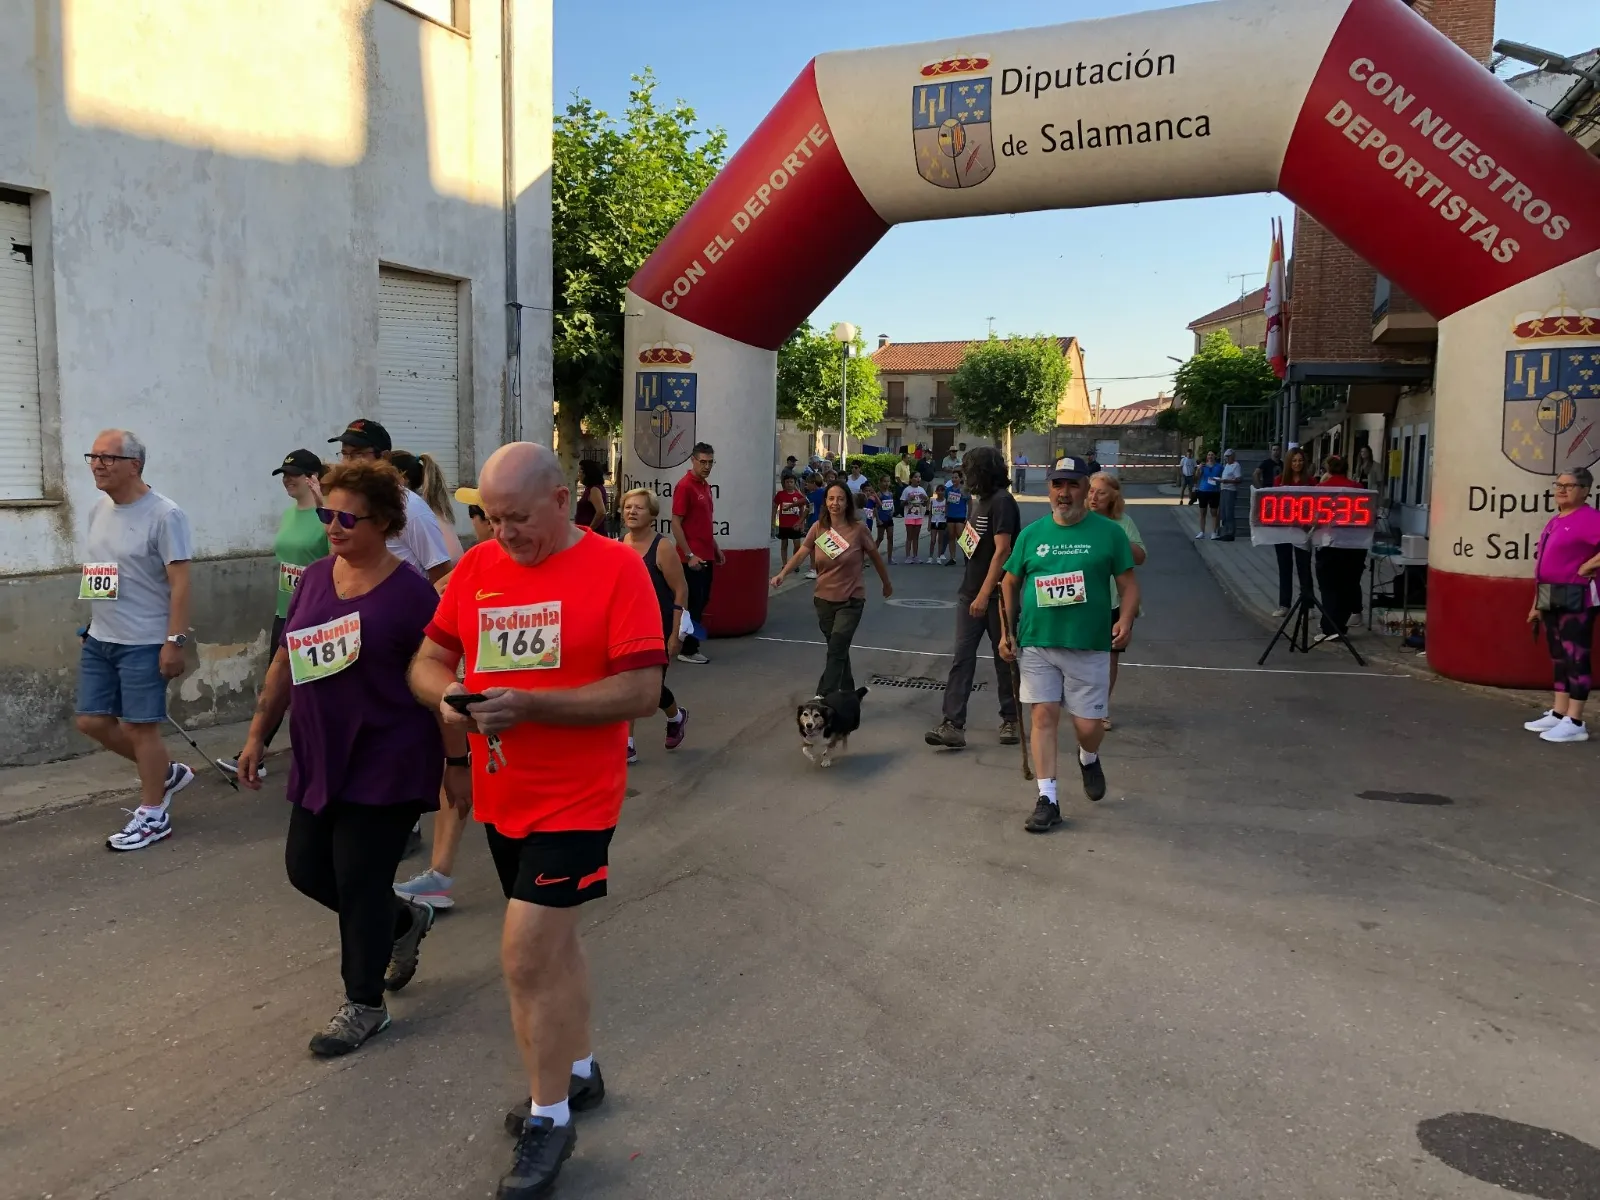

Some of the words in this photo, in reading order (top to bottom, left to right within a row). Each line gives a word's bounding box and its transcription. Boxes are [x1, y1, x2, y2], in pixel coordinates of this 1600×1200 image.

[1001, 49, 1175, 99] Diputación
[1001, 134, 1028, 157] de
[1041, 114, 1211, 153] Salamanca
[1348, 57, 1416, 115] CON
[1409, 106, 1571, 241] NUESTROS
[1324, 99, 1520, 263] DEPORTISTAS
[661, 260, 707, 310] CON
[703, 234, 735, 264] EL
[730, 123, 830, 234] DEPORTE
[1260, 496, 1371, 525] 00:05:35
[823, 537, 841, 552] 177
[1453, 536, 1474, 557] de
[88, 576, 111, 591] 180
[281, 564, 305, 577] bedu
[1036, 573, 1084, 588] bedunia
[1047, 584, 1076, 599] 175
[480, 608, 560, 632] bedunia
[288, 619, 360, 652] bedunia
[497, 628, 546, 657] 166
[307, 636, 347, 667] 181
